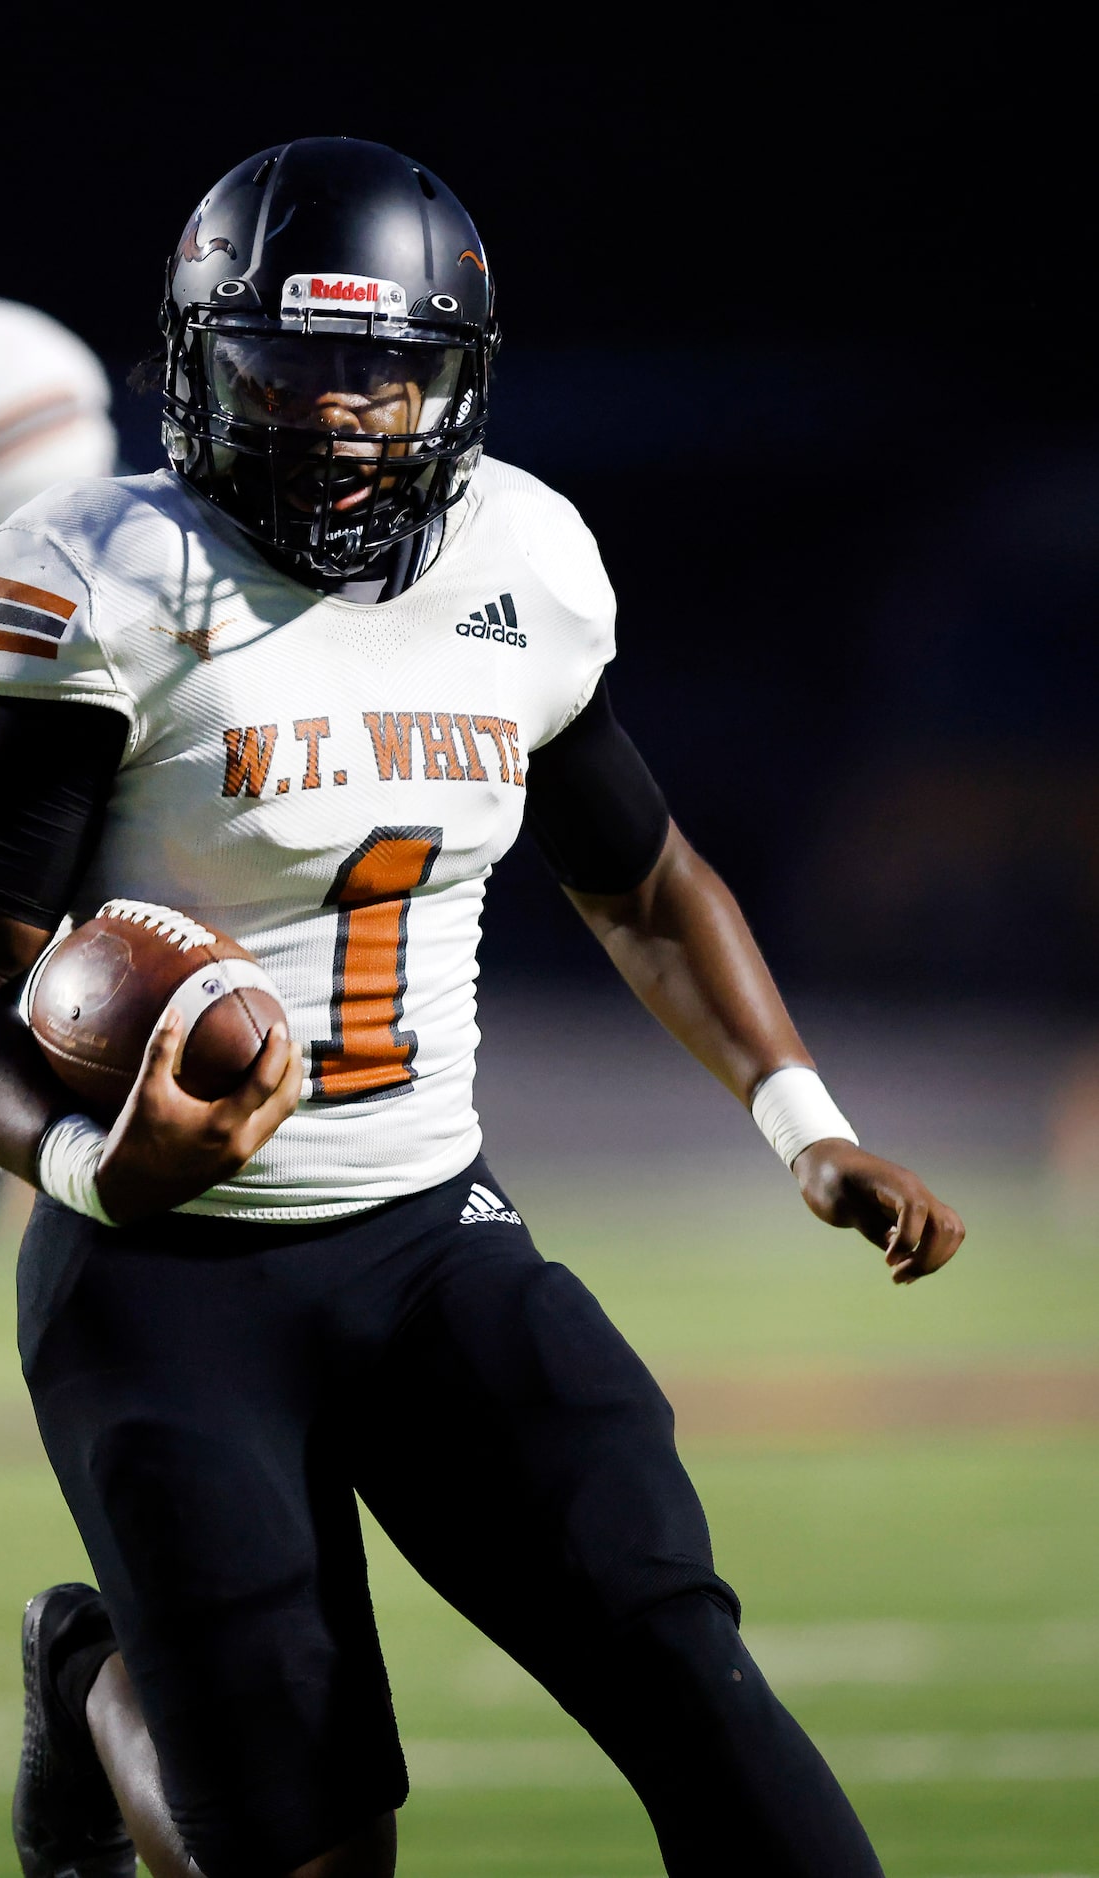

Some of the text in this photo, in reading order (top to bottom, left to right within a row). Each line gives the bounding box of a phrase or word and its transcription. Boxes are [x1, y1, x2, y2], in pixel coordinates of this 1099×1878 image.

[310, 278, 378, 302] Riddell
[455, 621, 527, 649] adidas
[221, 711, 526, 799] W.T. WHITE
[306, 825, 444, 1104] 1
[459, 1208, 522, 1226] adidas
